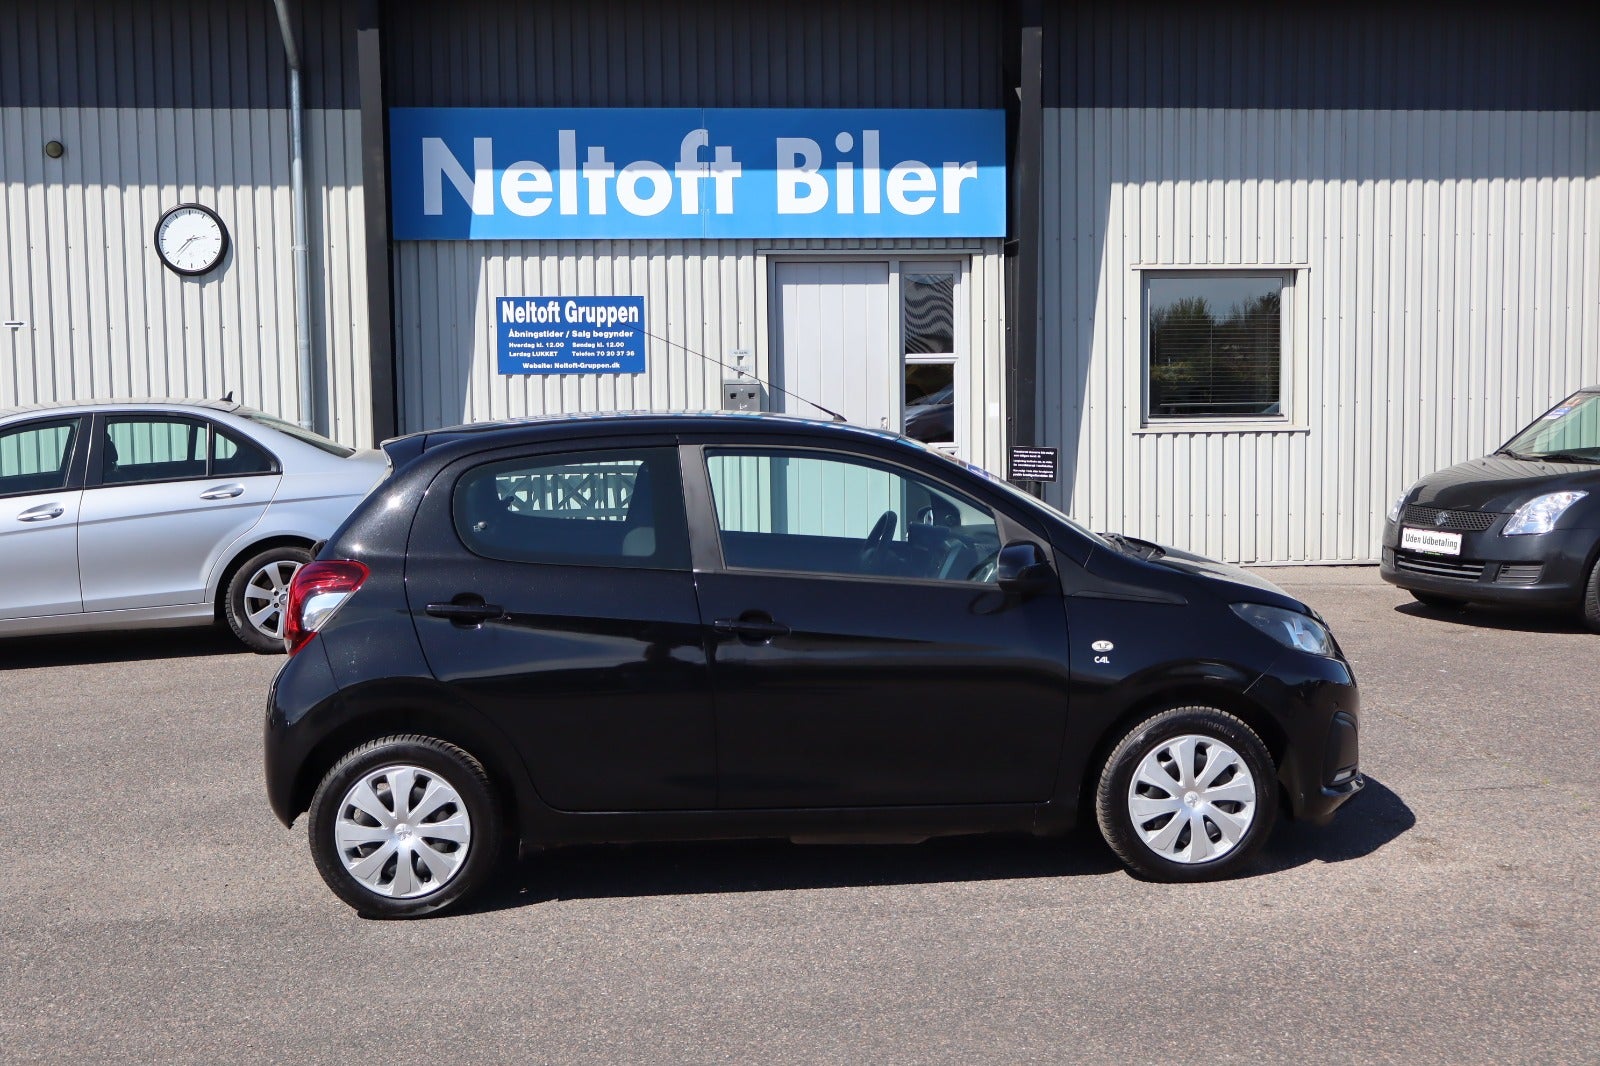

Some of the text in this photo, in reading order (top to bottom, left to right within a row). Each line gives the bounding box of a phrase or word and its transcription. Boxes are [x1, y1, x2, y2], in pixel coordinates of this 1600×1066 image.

[422, 129, 978, 216] Neltoft Biler
[502, 300, 639, 327] Neltoft Gruppen
[508, 328, 564, 338] Åbningstider
[571, 330, 591, 338] Salg
[592, 330, 634, 338] begynder
[554, 362, 621, 370] Neltoft-Gruppen.dk
[1405, 533, 1458, 551] Uden Udbetaling
